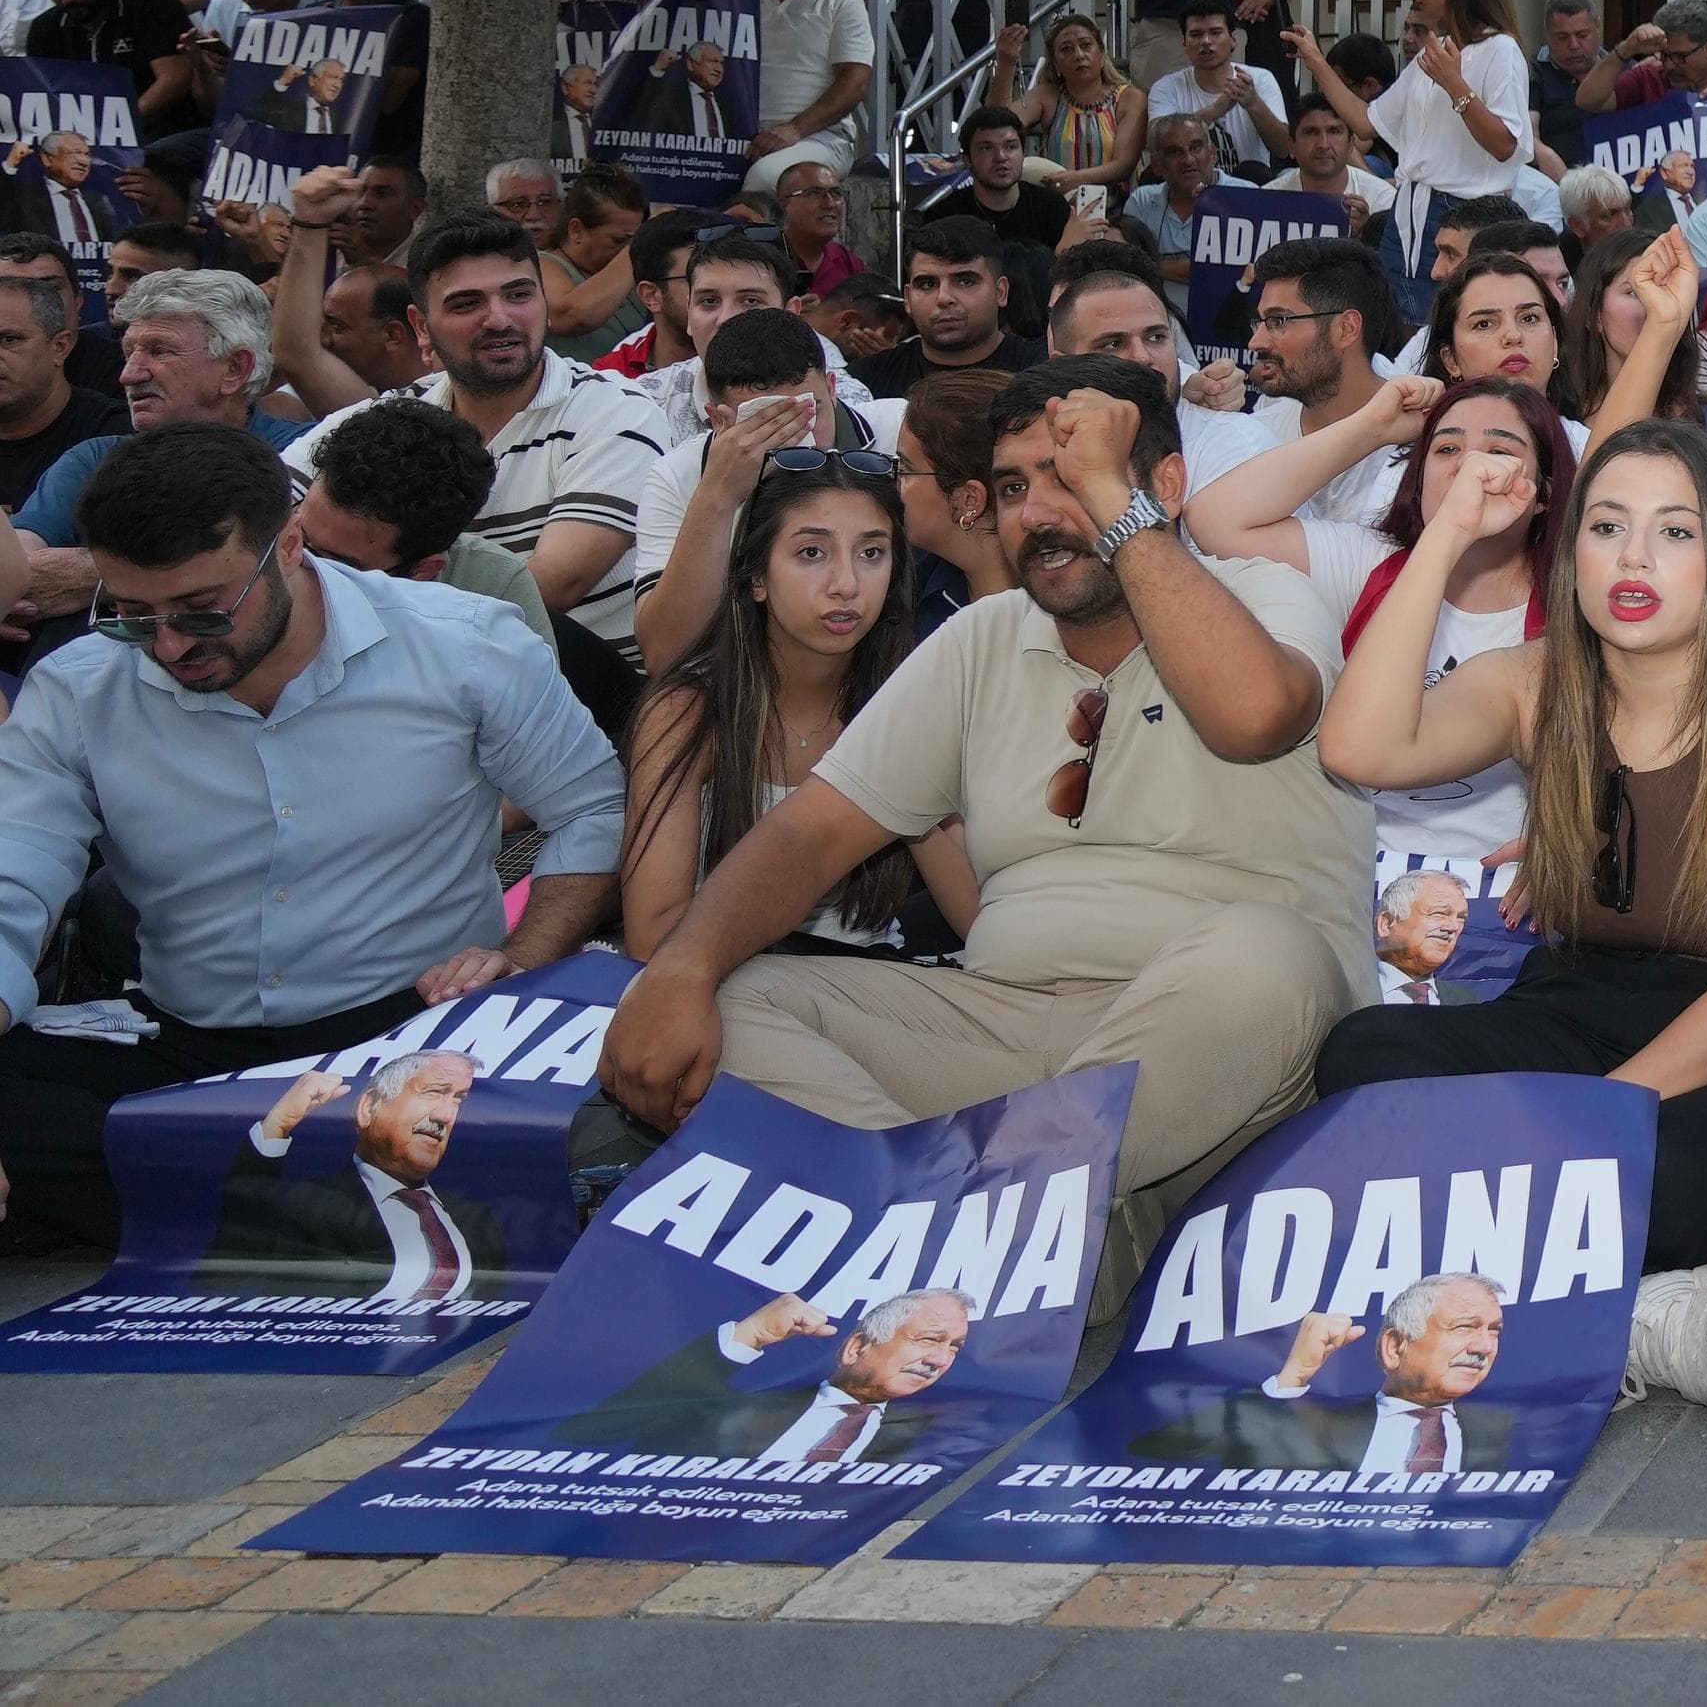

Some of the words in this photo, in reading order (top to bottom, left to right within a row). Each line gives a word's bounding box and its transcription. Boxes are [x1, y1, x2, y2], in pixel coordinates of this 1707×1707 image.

[233, 19, 386, 77] ADANA
[594, 130, 651, 148] ZEYDAN
[611, 1151, 1091, 1321] ADANA
[1134, 1158, 1624, 1352] ADANA
[52, 1296, 230, 1313] ZEYDAN
[231, 1297, 531, 1316] KARALAR'DIR
[7, 1329, 115, 1342] Adanalı
[254, 1332, 341, 1345] boyun
[96, 1318, 186, 1330] Adana
[188, 1318, 270, 1331] tutsak
[402, 1447, 606, 1475] ZEYDAN
[600, 1454, 943, 1485] KARALAR'DIR
[999, 1464, 1204, 1491] ZEYDAN
[1206, 1468, 1555, 1495] KARALAR'DIR
[456, 1479, 556, 1494] Adana
[560, 1482, 653, 1499] tutsak
[656, 1488, 803, 1506] edilemez,
[1071, 1495, 1174, 1510] Adana
[1180, 1498, 1276, 1512] tutsak
[1282, 1499, 1434, 1517] edilemez,
[361, 1493, 484, 1510] Adanalı
[487, 1496, 641, 1515] haksızlığa
[644, 1502, 739, 1520] boyun
[741, 1504, 848, 1523] eğmez.
[983, 1508, 1106, 1523] Adanalı
[1113, 1510, 1269, 1529] haksızlığa
[1275, 1513, 1371, 1530] boyun
[1376, 1515, 1493, 1532] eğmez.
